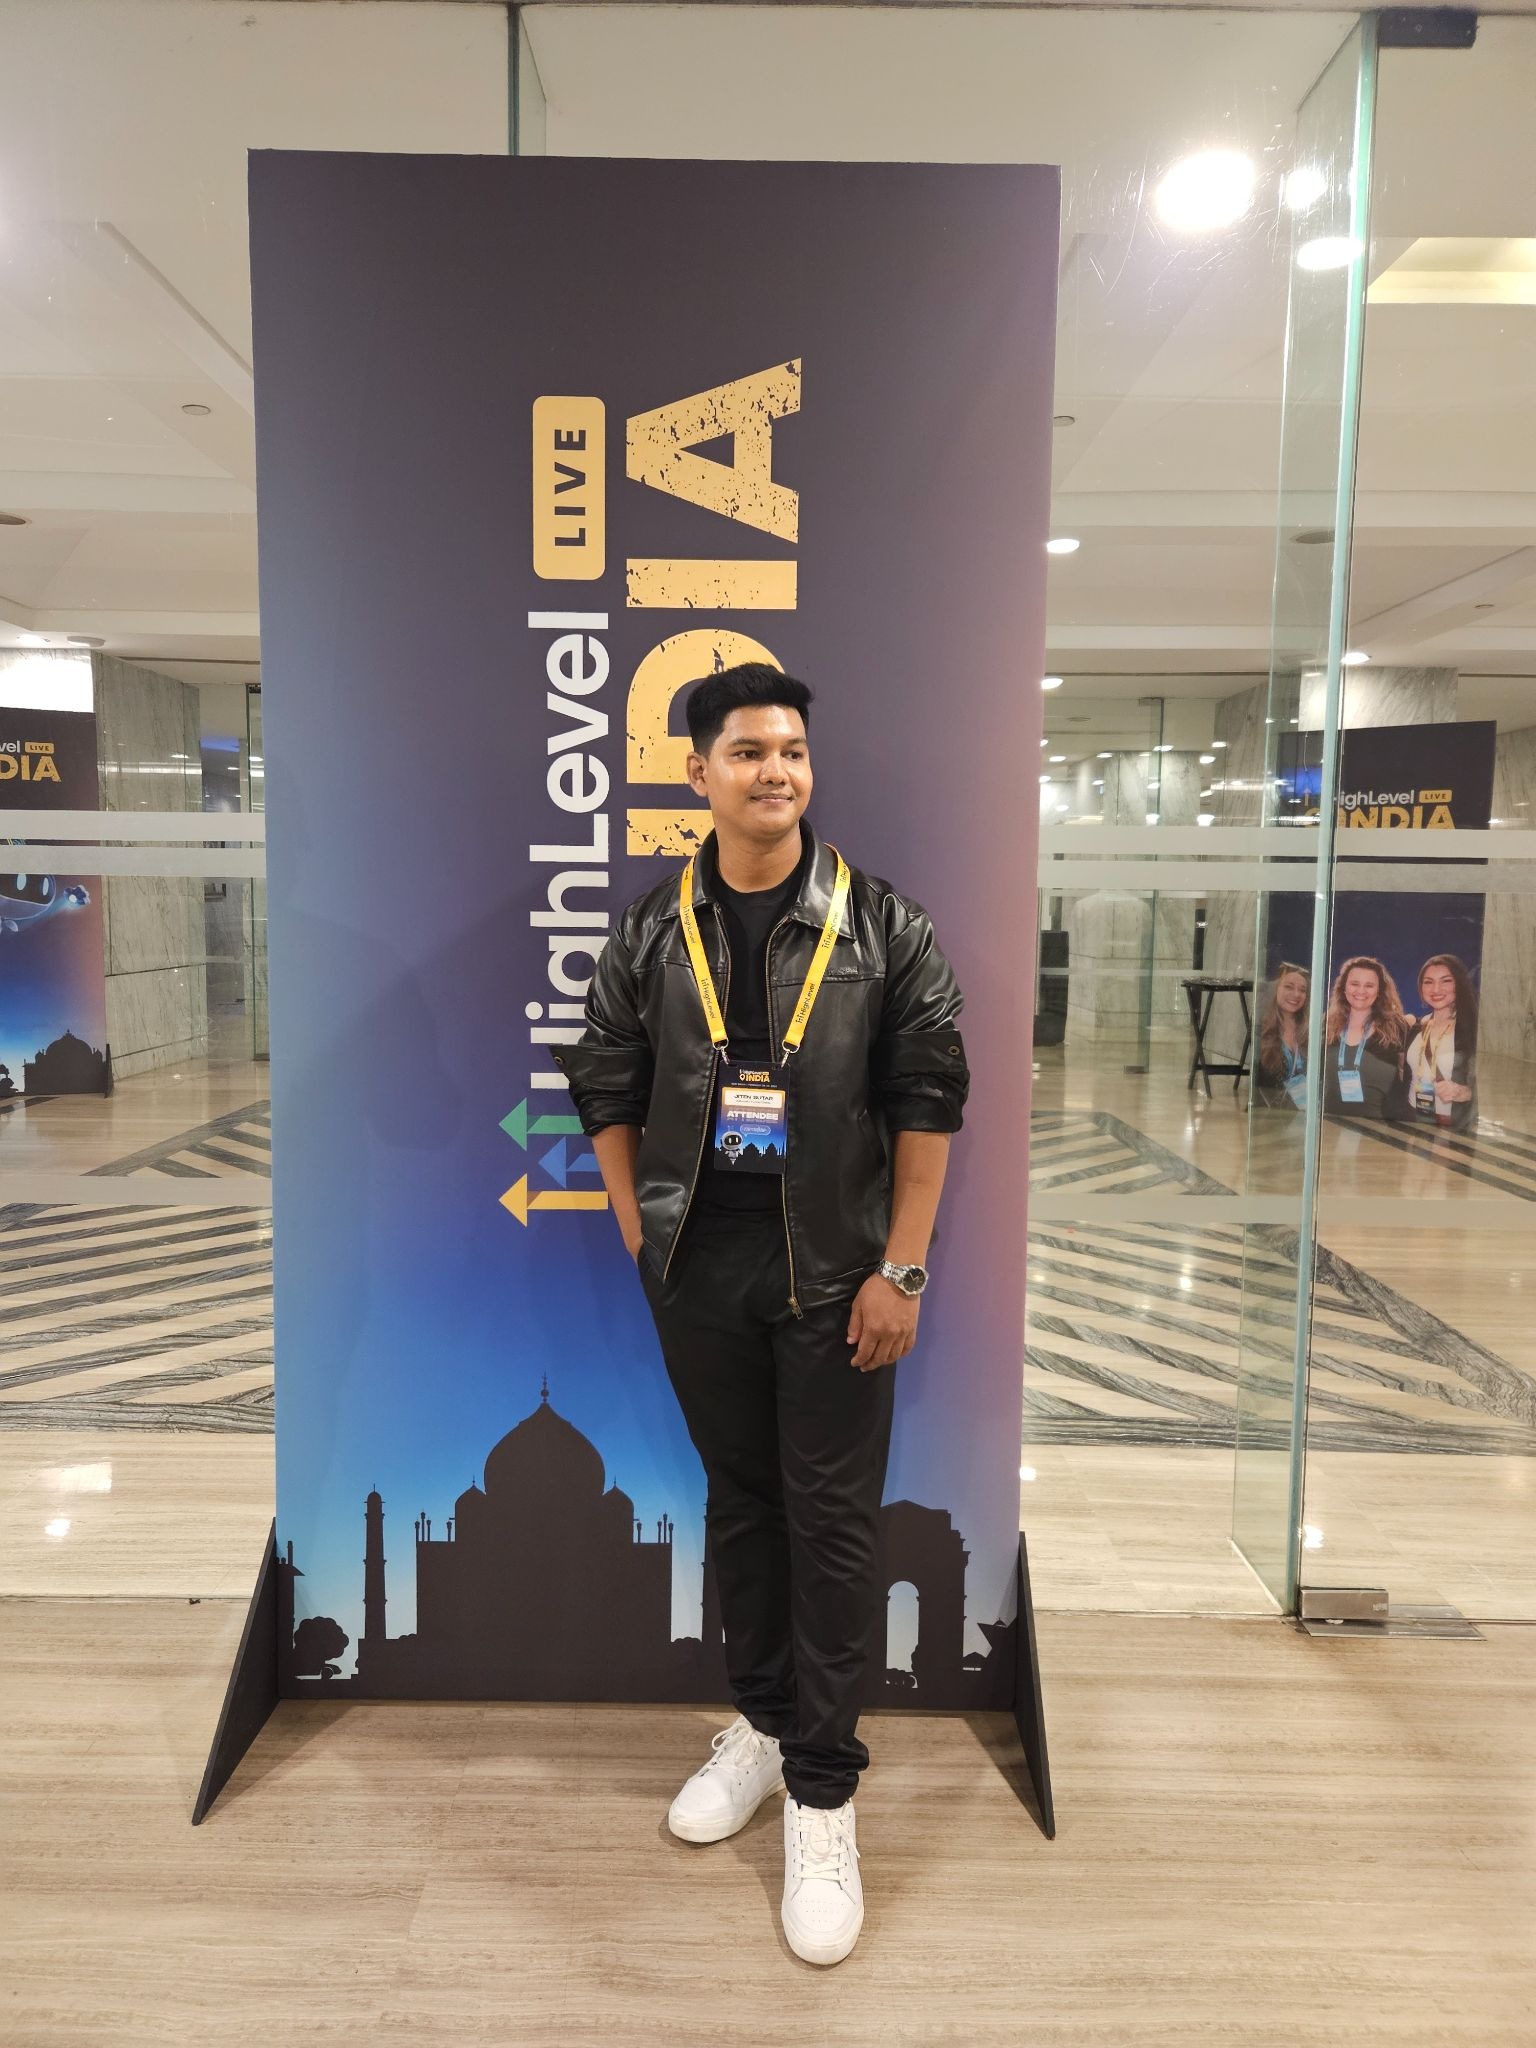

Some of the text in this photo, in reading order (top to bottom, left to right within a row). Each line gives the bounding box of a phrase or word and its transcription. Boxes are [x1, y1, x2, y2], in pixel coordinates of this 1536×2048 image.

[554, 428, 587, 547] LIVE
[626, 357, 802, 856] DIA
[0, 753, 61, 782] DIA
[1334, 789, 1447, 810] ighLevel LIVE
[800, 982, 816, 1017] HighLevel
[745, 1074, 771, 1083] INDIA
[727, 1110, 779, 1121] ATTENDEE
